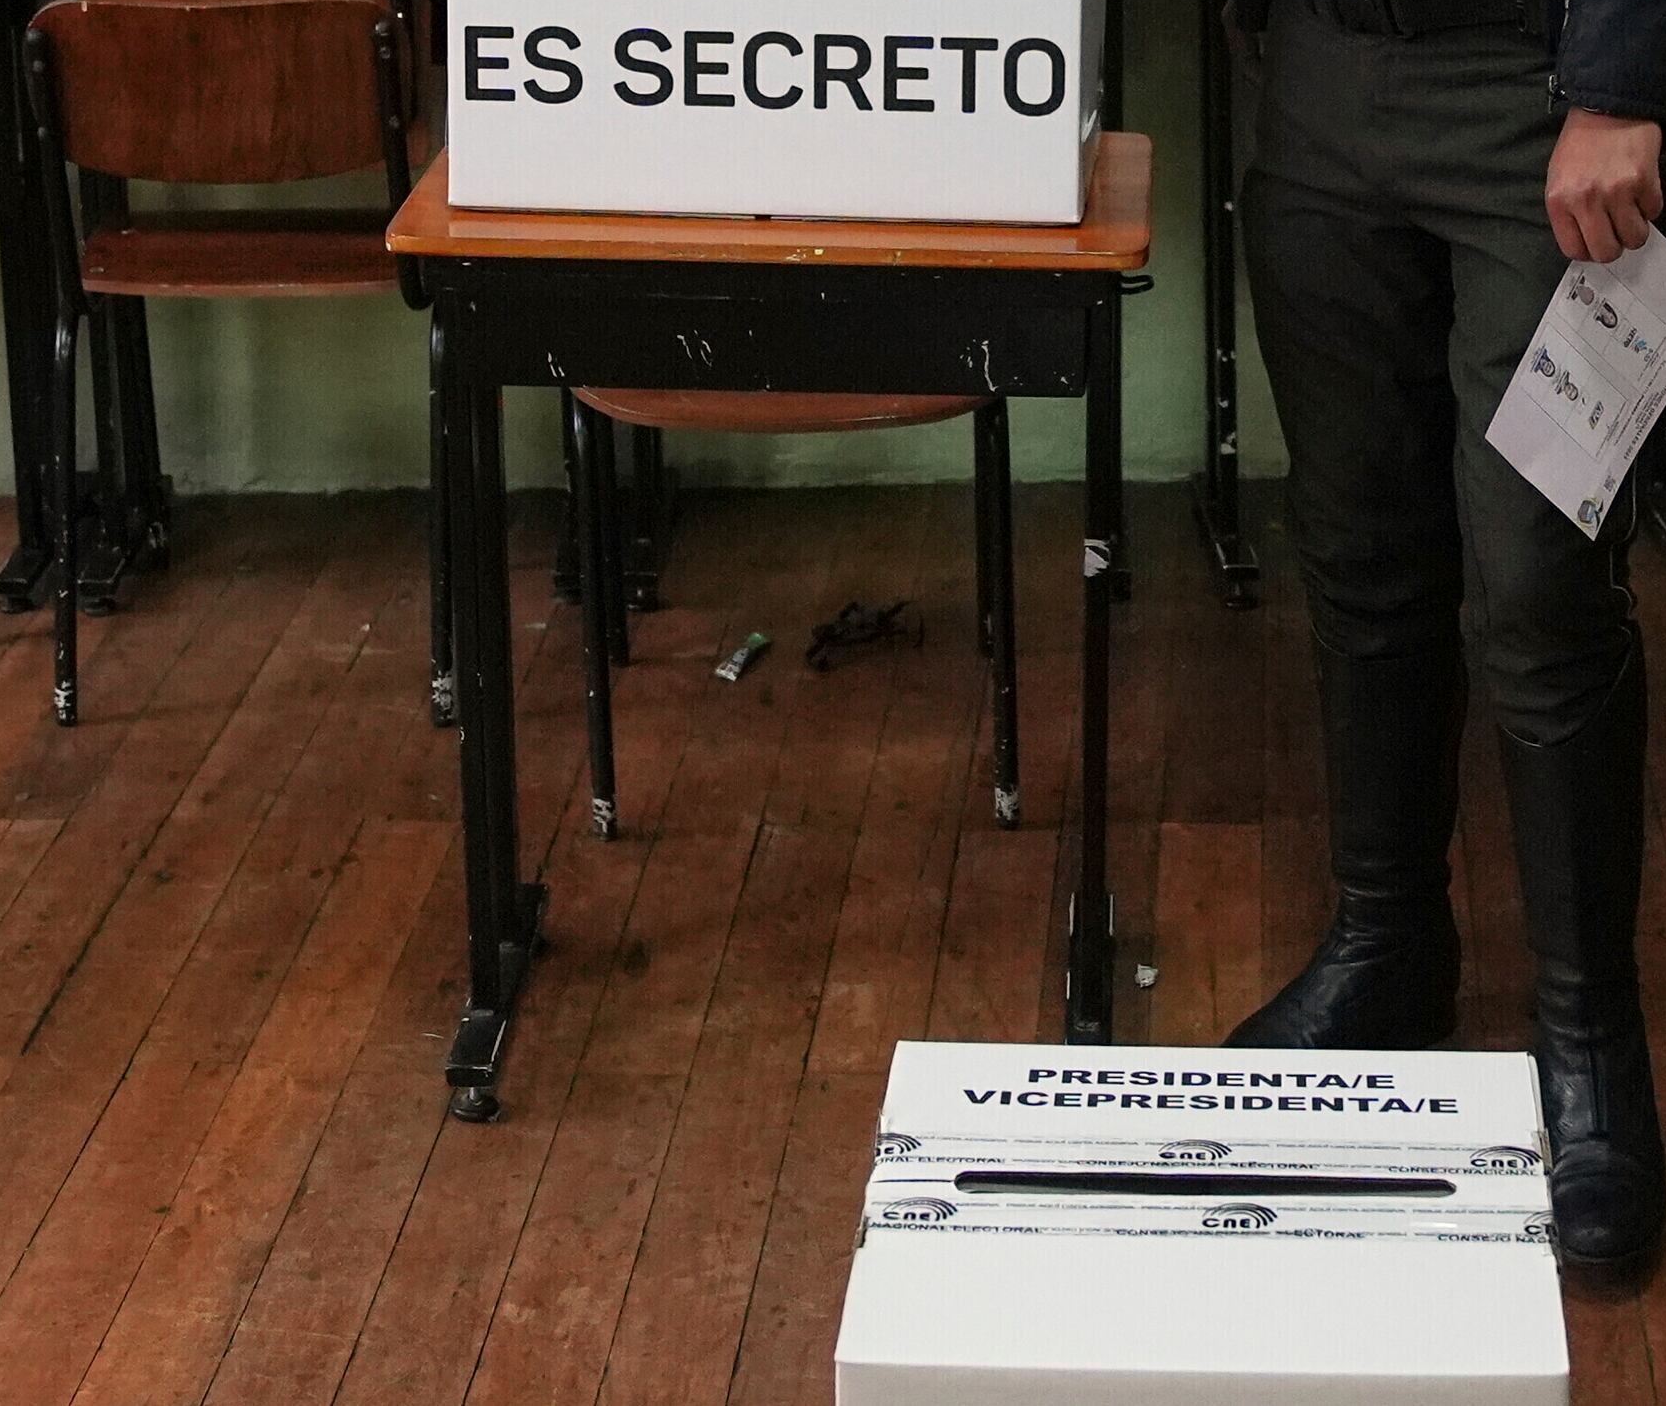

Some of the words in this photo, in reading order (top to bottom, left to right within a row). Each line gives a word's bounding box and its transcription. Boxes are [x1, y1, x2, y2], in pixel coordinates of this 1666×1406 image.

[465, 26, 583, 104] ES
[614, 28, 1065, 116] SECRETO
[1028, 1069, 1395, 1089] PRESIDENTA/E
[964, 1090, 1459, 1113] VICEPRESIDENTA/E
[1202, 1218, 1251, 1228] CNE
